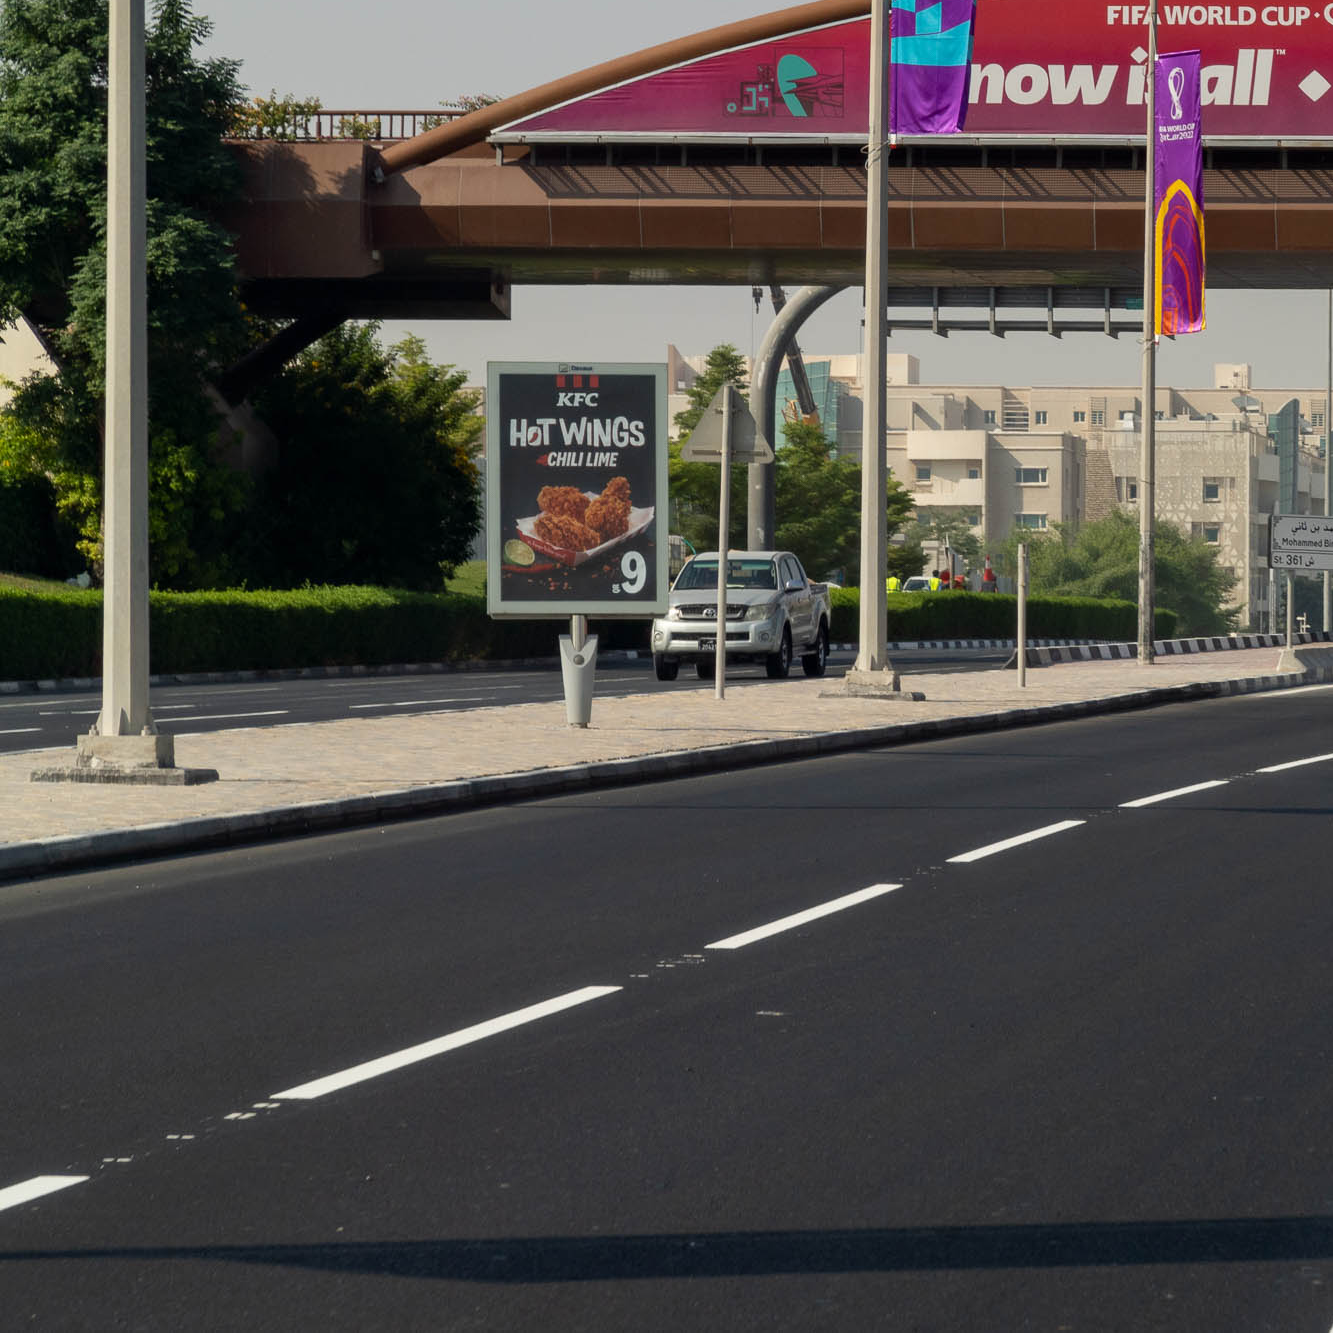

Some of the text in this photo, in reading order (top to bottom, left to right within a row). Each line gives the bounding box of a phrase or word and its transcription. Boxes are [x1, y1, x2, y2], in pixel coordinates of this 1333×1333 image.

[1164, 5, 1256, 26] WORLD
[1261, 5, 1310, 26] CUP
[968, 63, 1119, 105] now
[556, 392, 599, 406] KFC
[547, 452, 619, 466] CHILI LIME
[1310, 524, 1320, 534] بن
[1282, 538, 1322, 548] Mohammed
[1286, 554, 1302, 565] 361
[621, 551, 646, 594] 9
